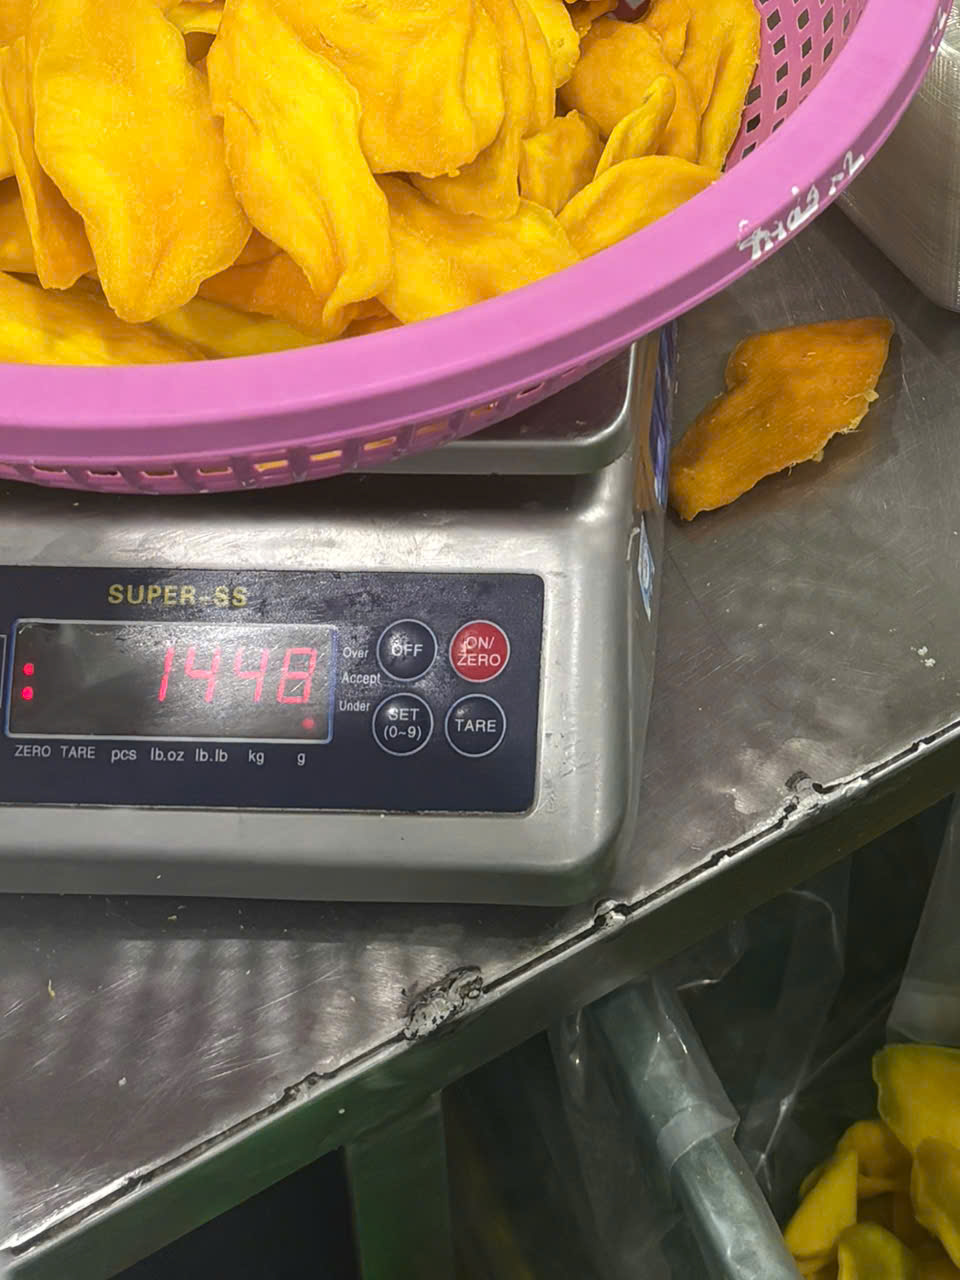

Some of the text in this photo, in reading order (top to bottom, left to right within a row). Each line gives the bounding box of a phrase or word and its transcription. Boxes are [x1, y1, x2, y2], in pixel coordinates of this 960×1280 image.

[342, 646, 369, 658] Over
[391, 644, 423, 657] OFF
[457, 653, 501, 666] ZERO
[158, 648, 317, 704] 1448
[341, 672, 381, 685] Accept
[339, 701, 371, 712] Under
[388, 709, 420, 721] SET
[455, 719, 497, 733] TARE
[14, 745, 306, 766] ZERO TARE pcs lb.oz lb.lb kg g
